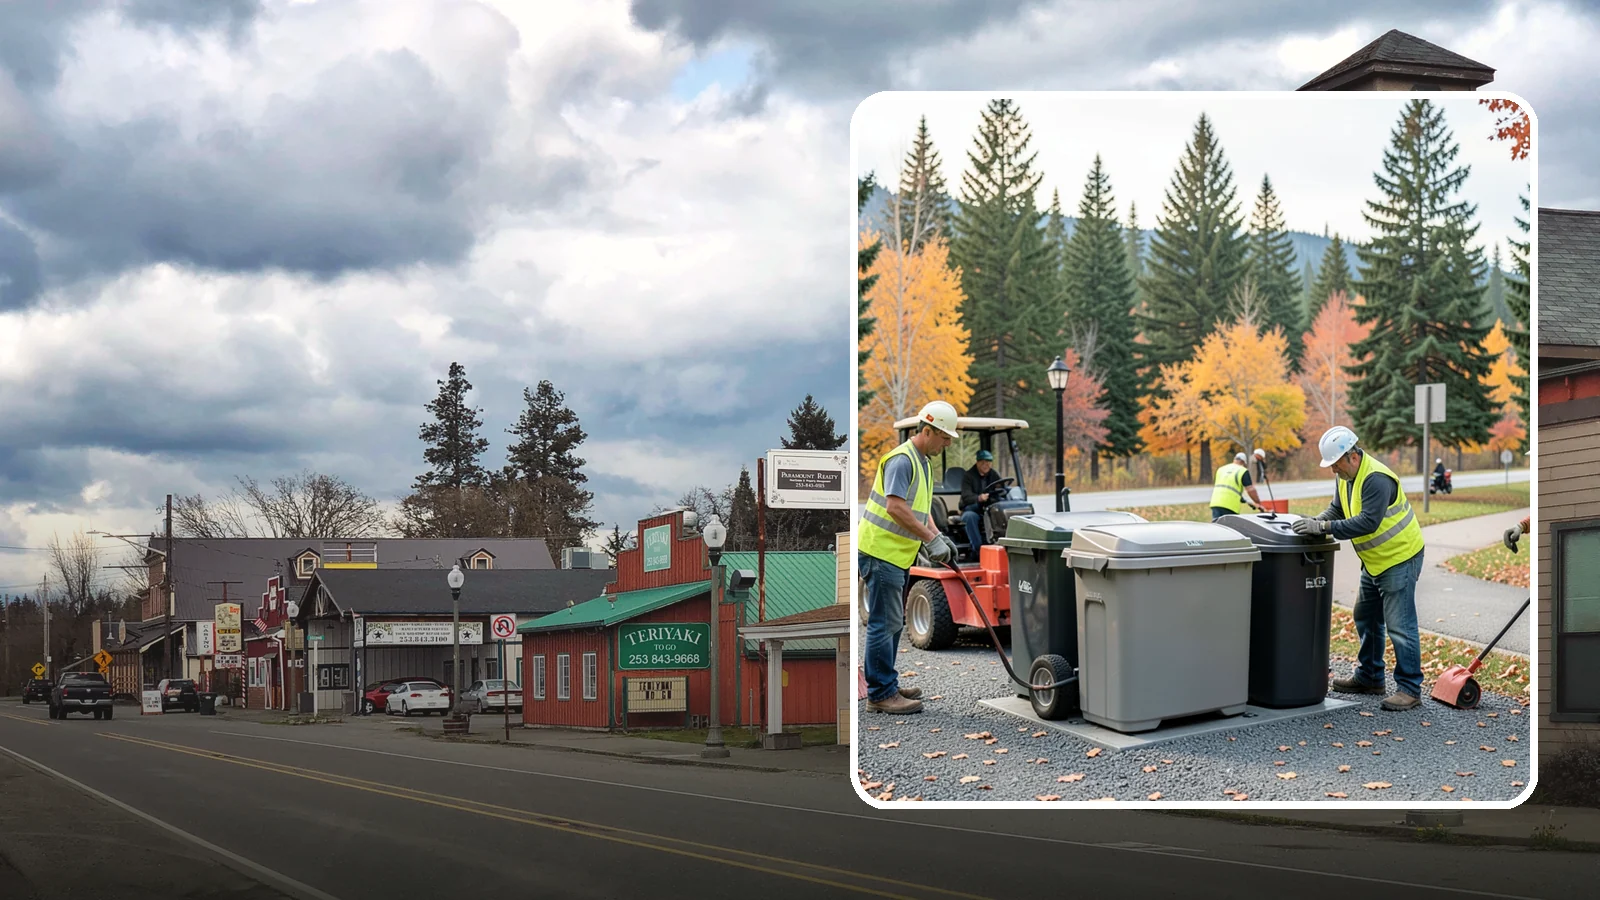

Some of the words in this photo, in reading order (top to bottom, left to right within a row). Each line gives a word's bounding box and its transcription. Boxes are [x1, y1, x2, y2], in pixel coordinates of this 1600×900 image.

[817, 472, 839, 480] REALTY
[624, 627, 703, 646] TERIYAKI
[654, 643, 665, 651] TO
[665, 643, 677, 651] GO
[628, 654, 649, 665] 253
[651, 653, 700, 664] 843-9668
